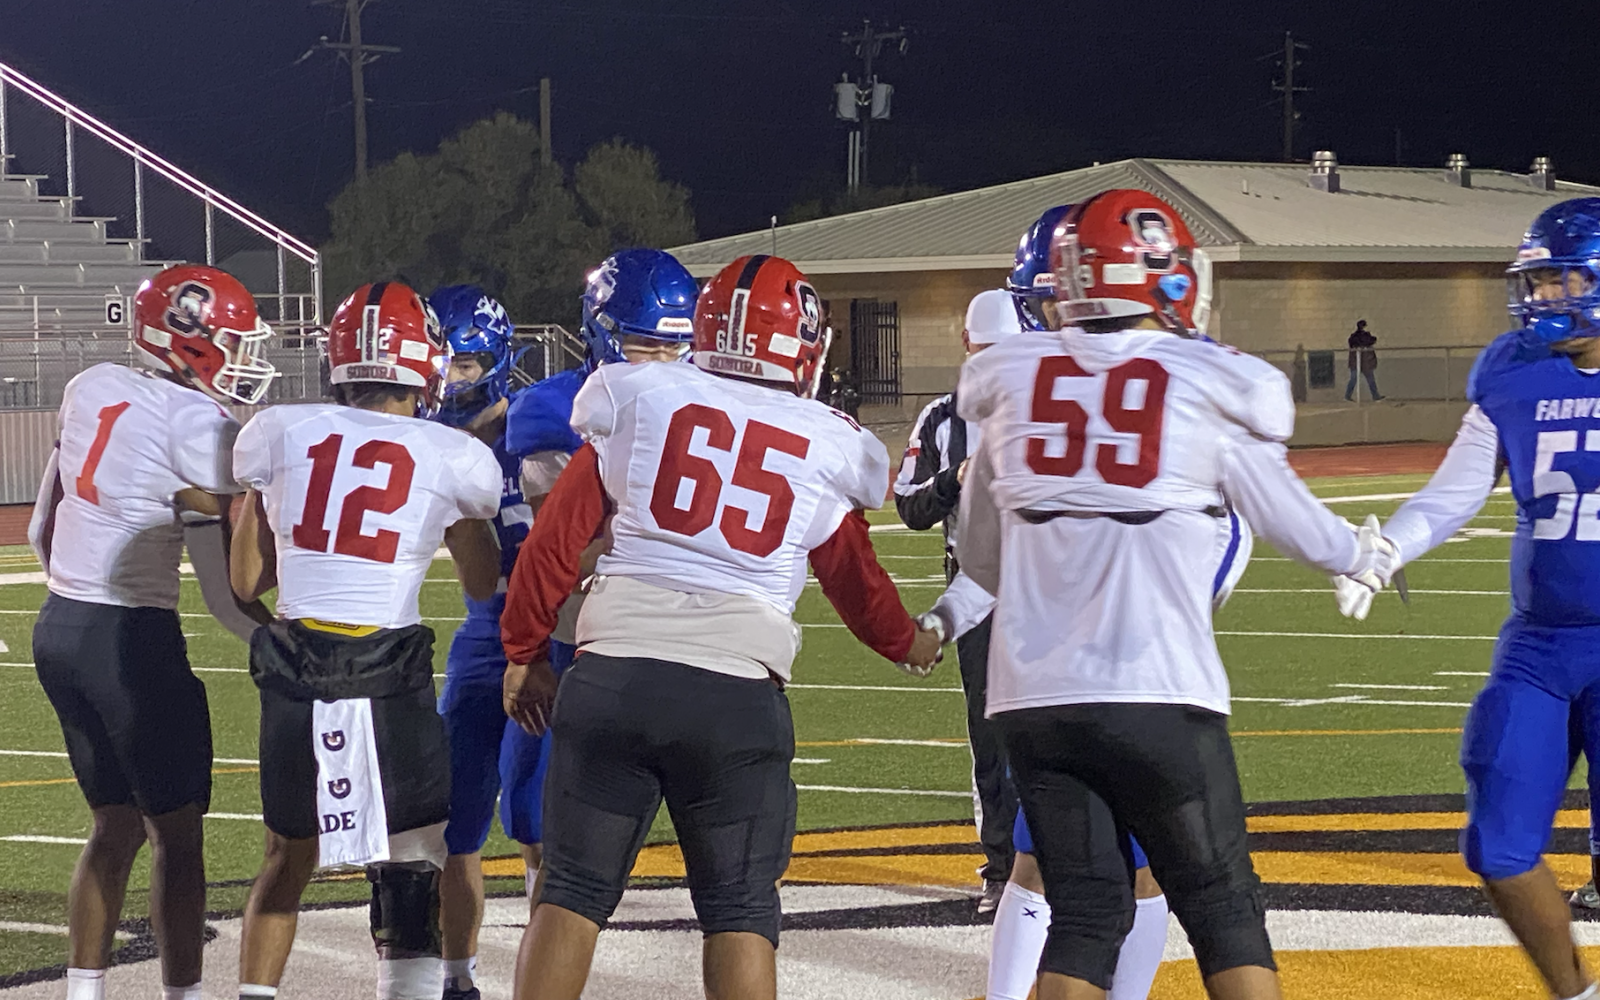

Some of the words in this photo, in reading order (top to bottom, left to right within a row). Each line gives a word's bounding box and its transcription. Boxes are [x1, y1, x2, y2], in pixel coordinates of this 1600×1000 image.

[107, 302, 122, 323] G
[347, 365, 398, 381] SONORA
[709, 355, 763, 376] SONORA
[1026, 355, 1170, 488] 59
[76, 401, 131, 505] 1
[649, 403, 810, 558] 65
[292, 433, 415, 564] 12
[322, 730, 345, 751] G
[328, 778, 352, 799] G
[320, 810, 357, 834] DE
